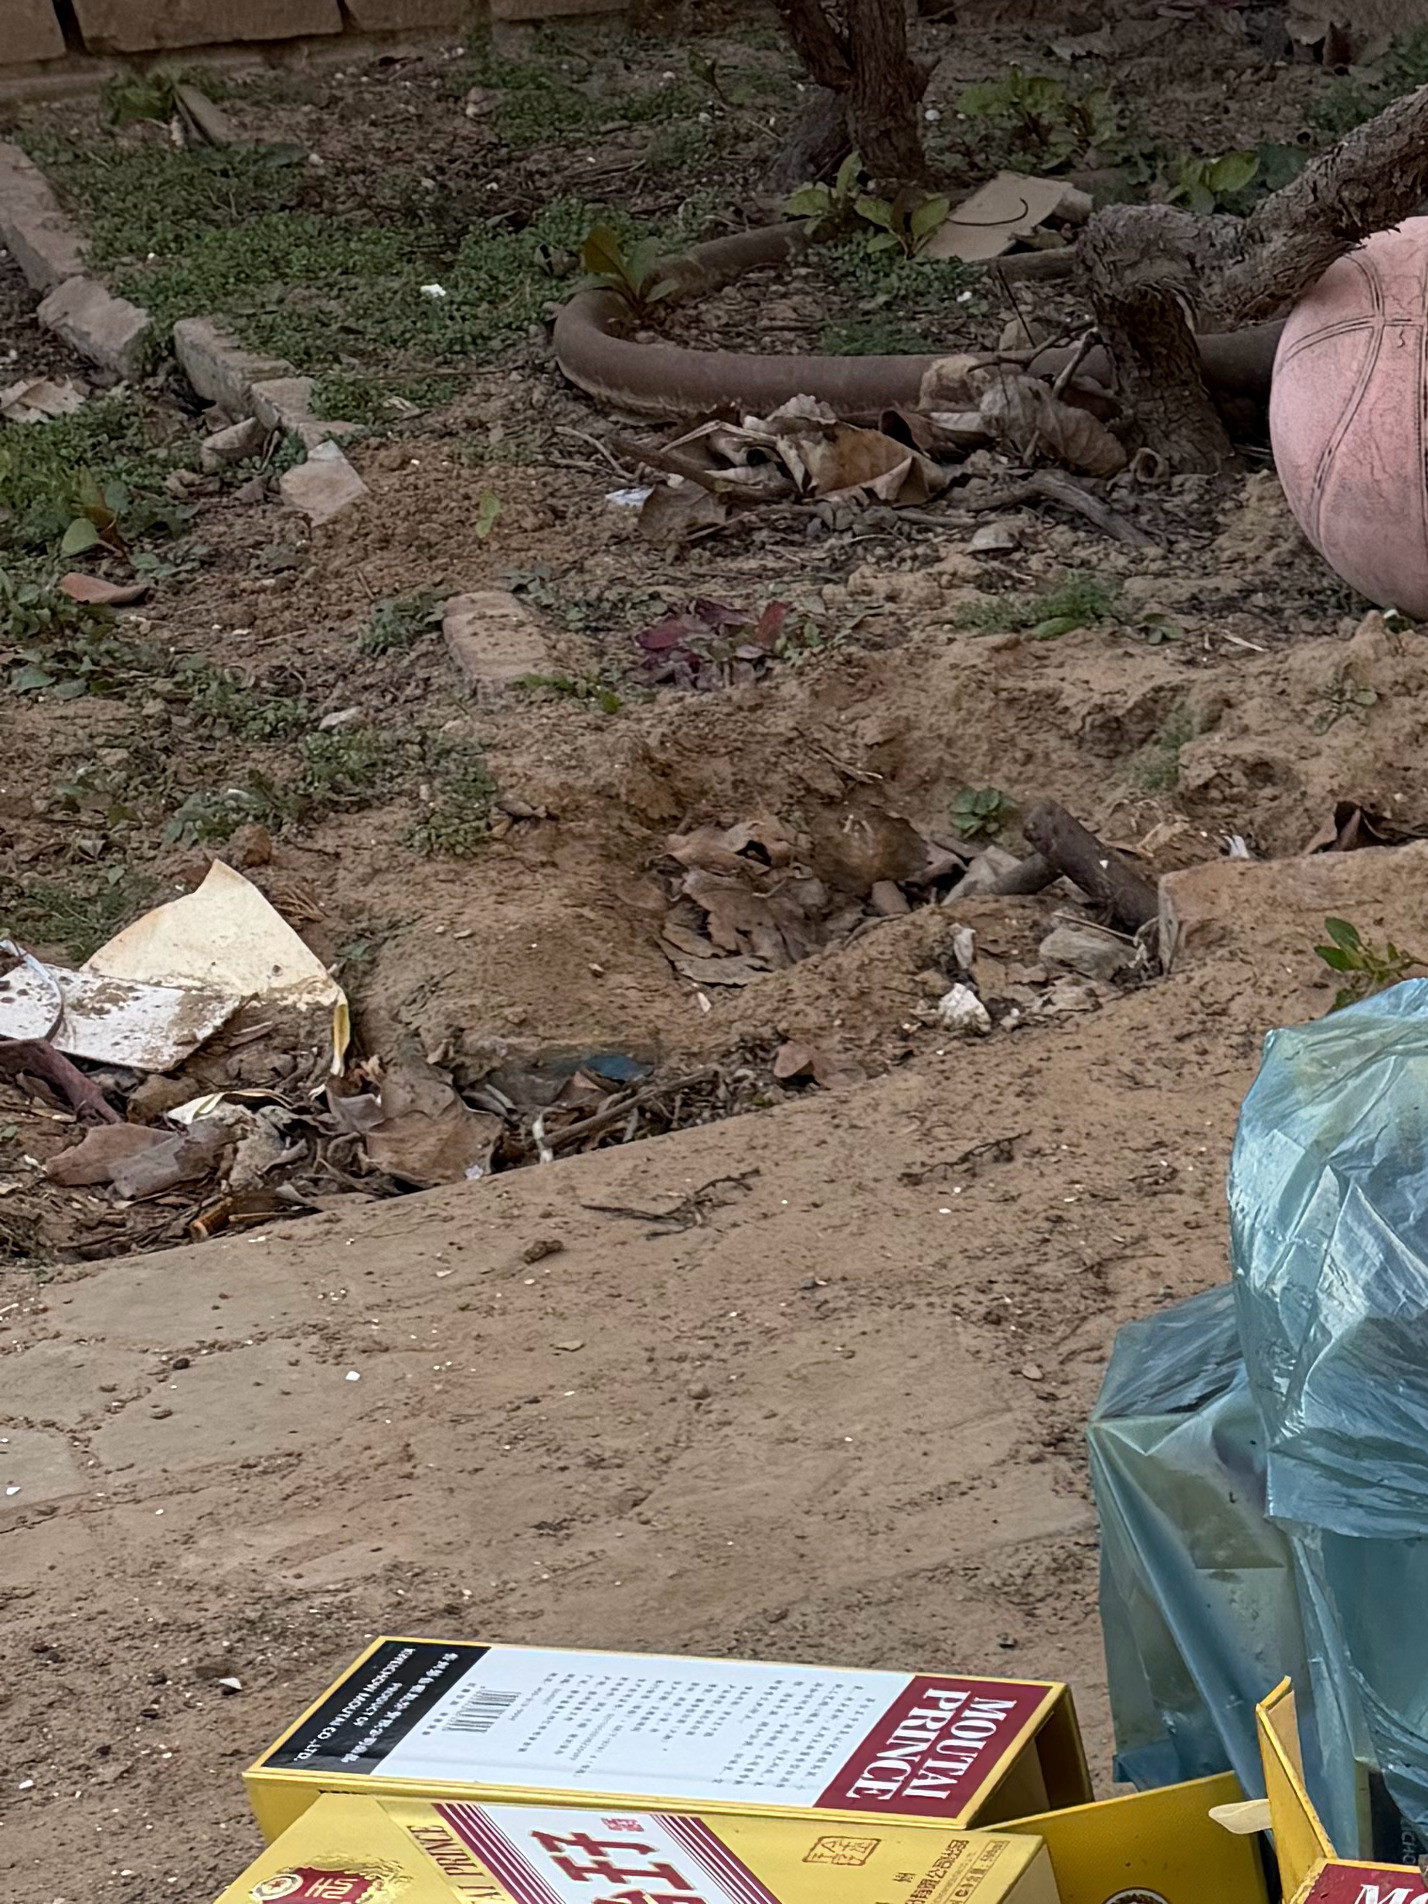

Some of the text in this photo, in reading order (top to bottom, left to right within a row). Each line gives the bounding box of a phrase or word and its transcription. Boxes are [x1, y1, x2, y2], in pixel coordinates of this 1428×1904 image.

[845, 1688, 971, 1800] PRINCE
[902, 1696, 1018, 1800] MOUTAI
[406, 1825, 486, 1877] PRINCE
